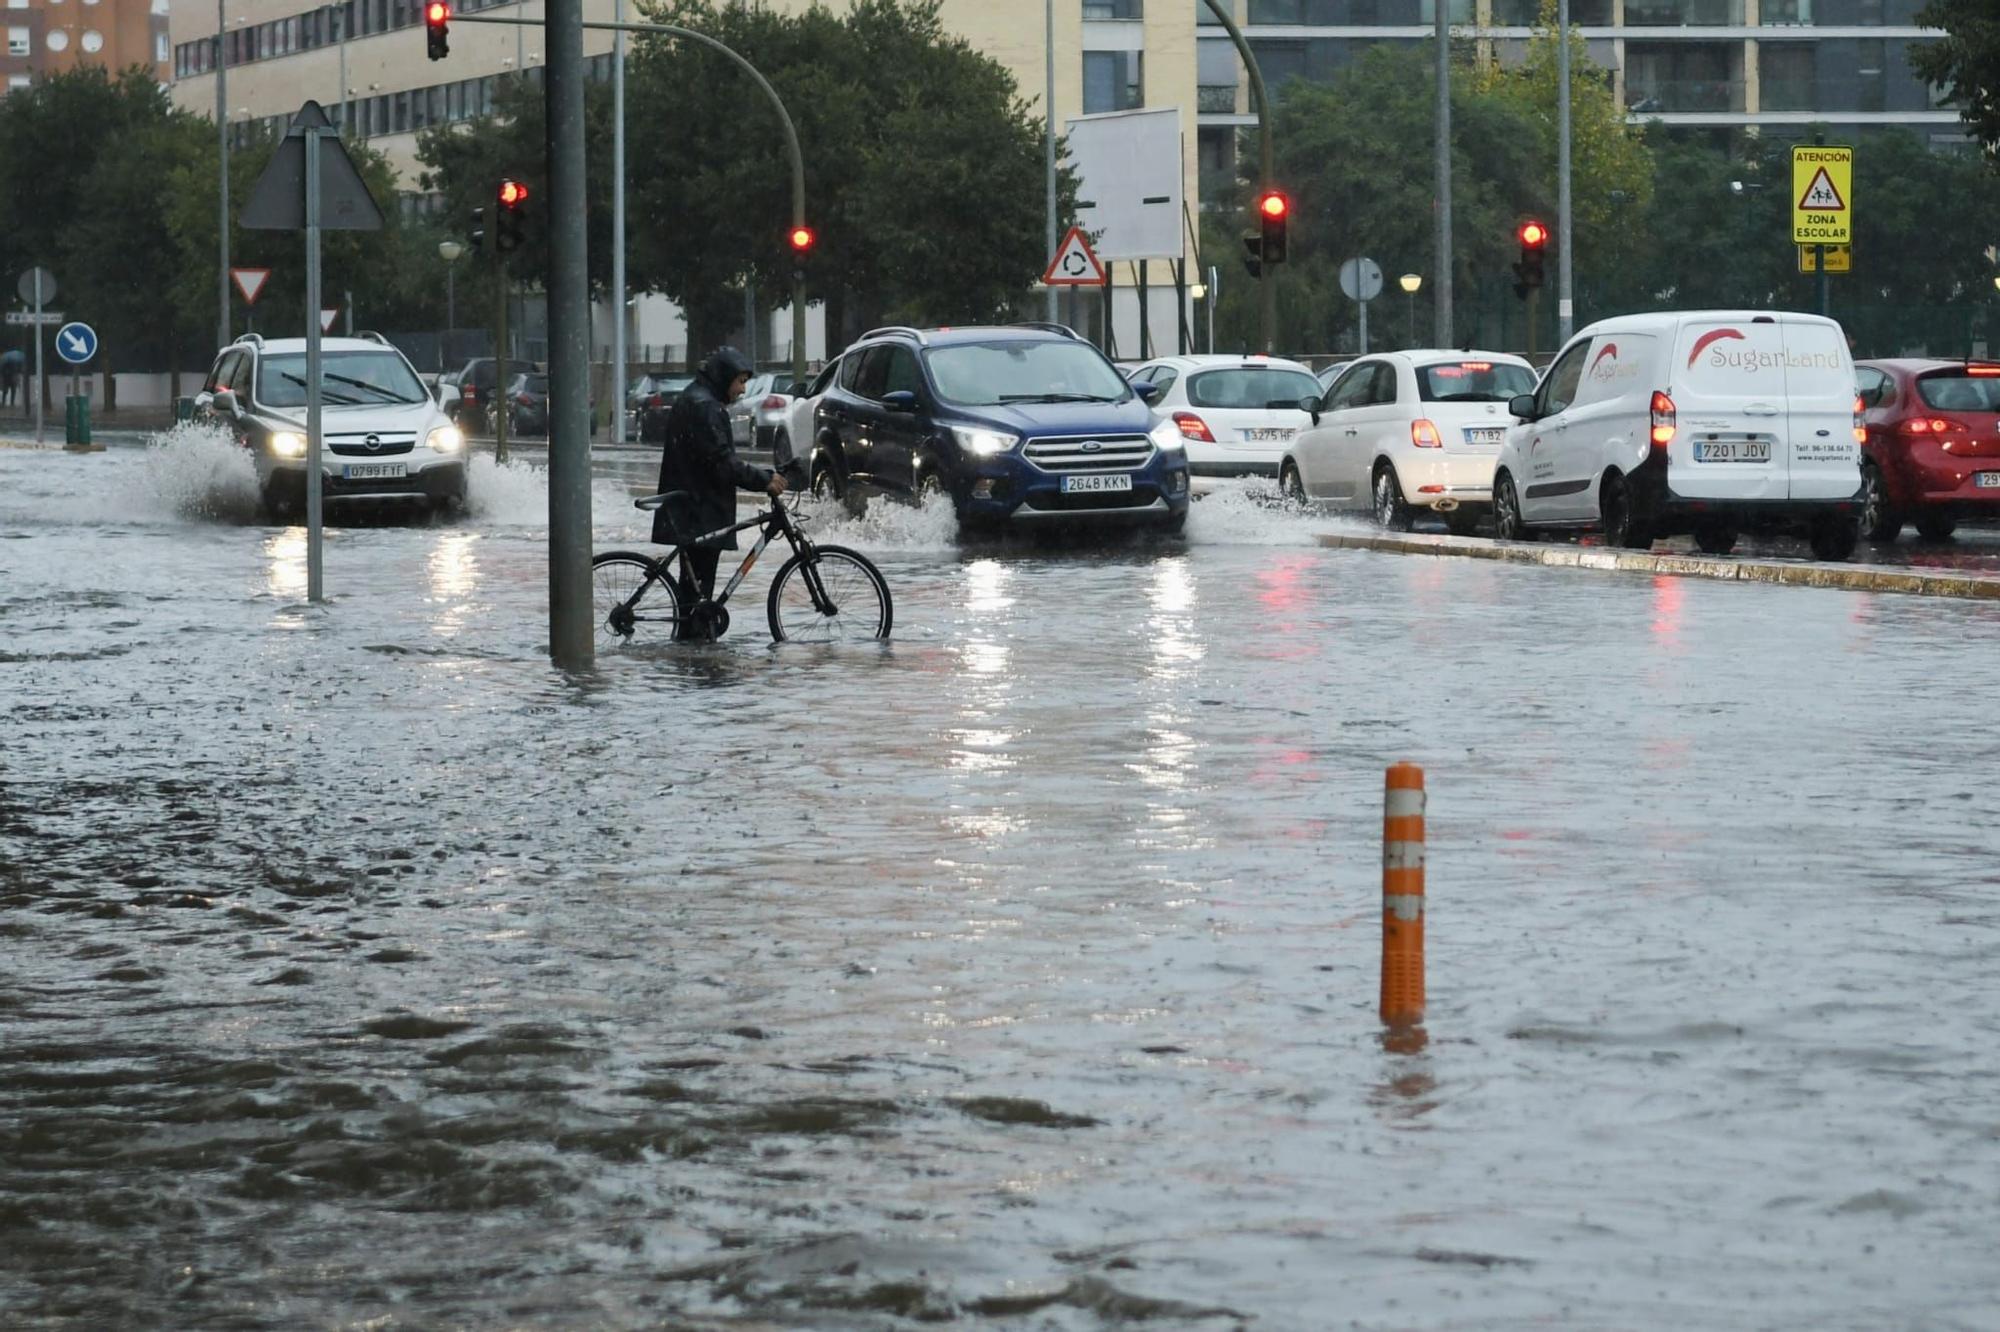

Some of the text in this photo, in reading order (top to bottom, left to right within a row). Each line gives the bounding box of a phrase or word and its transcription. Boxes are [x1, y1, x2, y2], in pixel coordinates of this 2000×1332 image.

[1796, 152, 1850, 162] ATENCIÓN
[1807, 214, 1836, 224] ZONA
[1797, 227, 1846, 237] ESCOLAR
[1711, 346, 1840, 373] SugarLand
[1251, 430, 1277, 441] 3275
[1473, 430, 1501, 441] 7182
[1703, 444, 1767, 458] 7201 JDV
[351, 465, 380, 477] 0799
[1069, 475, 1128, 491] 2648 KKN
[1984, 474, 2000, 486] 29
